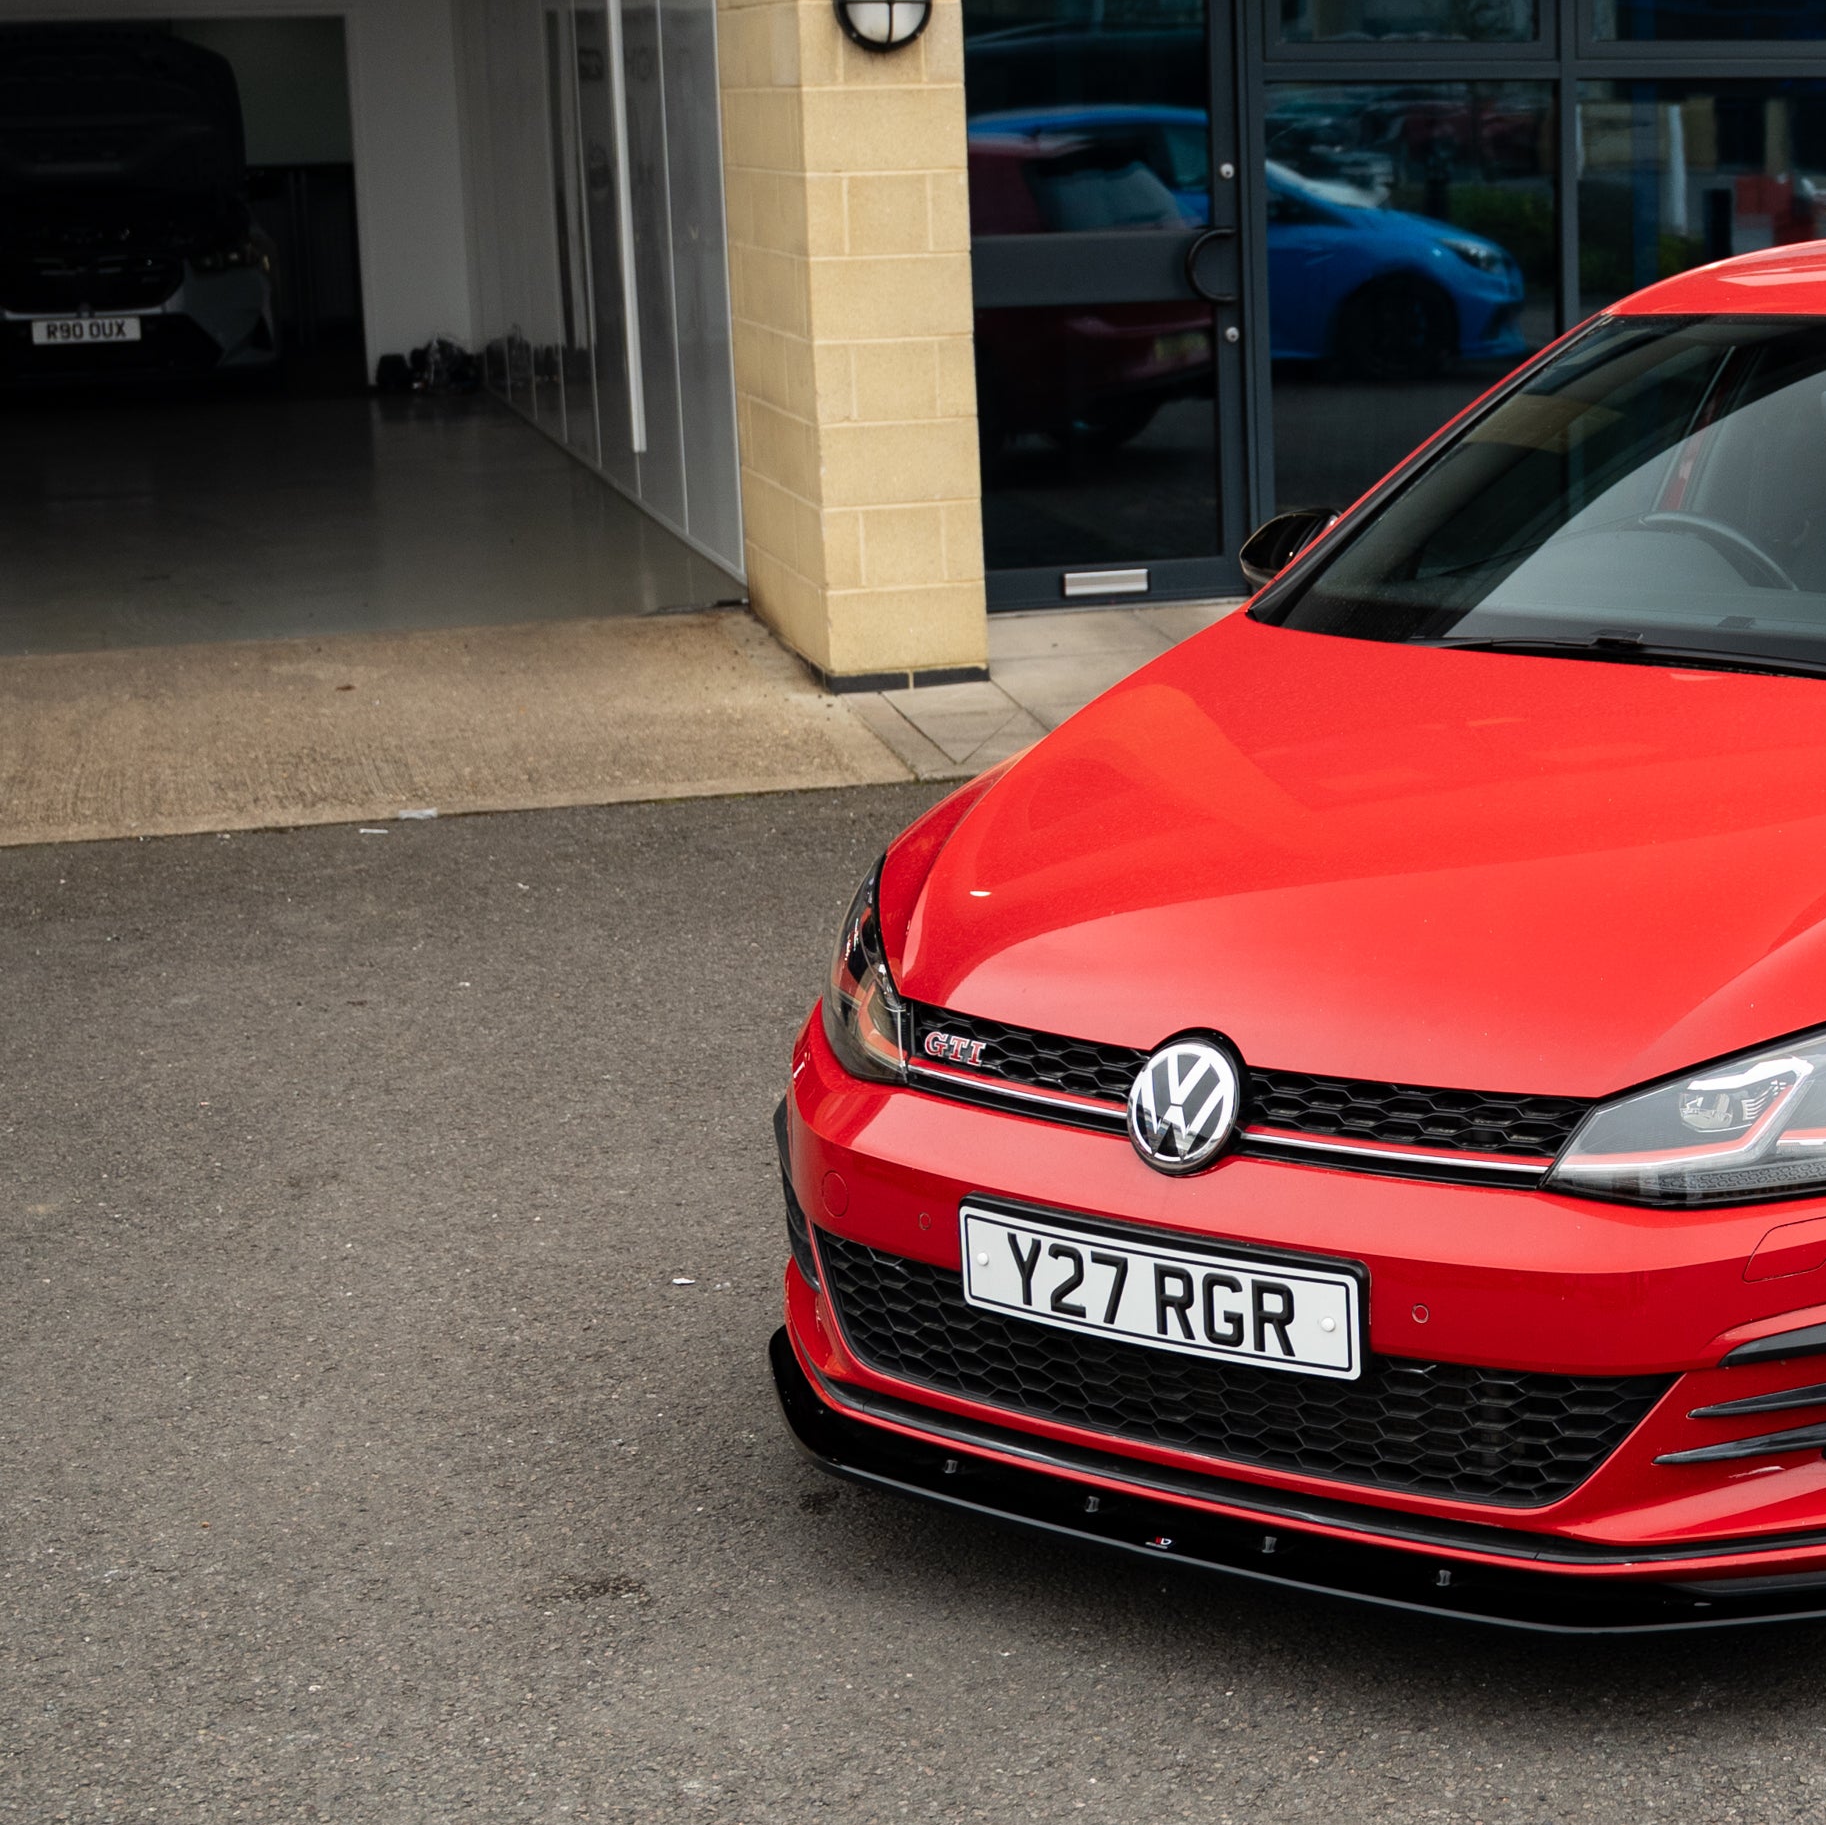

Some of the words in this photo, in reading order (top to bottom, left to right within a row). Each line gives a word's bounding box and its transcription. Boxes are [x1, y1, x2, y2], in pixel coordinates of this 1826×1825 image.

[47, 321, 84, 340] R90
[924, 1030, 987, 1067] GTI
[1006, 1231, 1129, 1325] Y27
[1153, 1261, 1296, 1358] RGR
